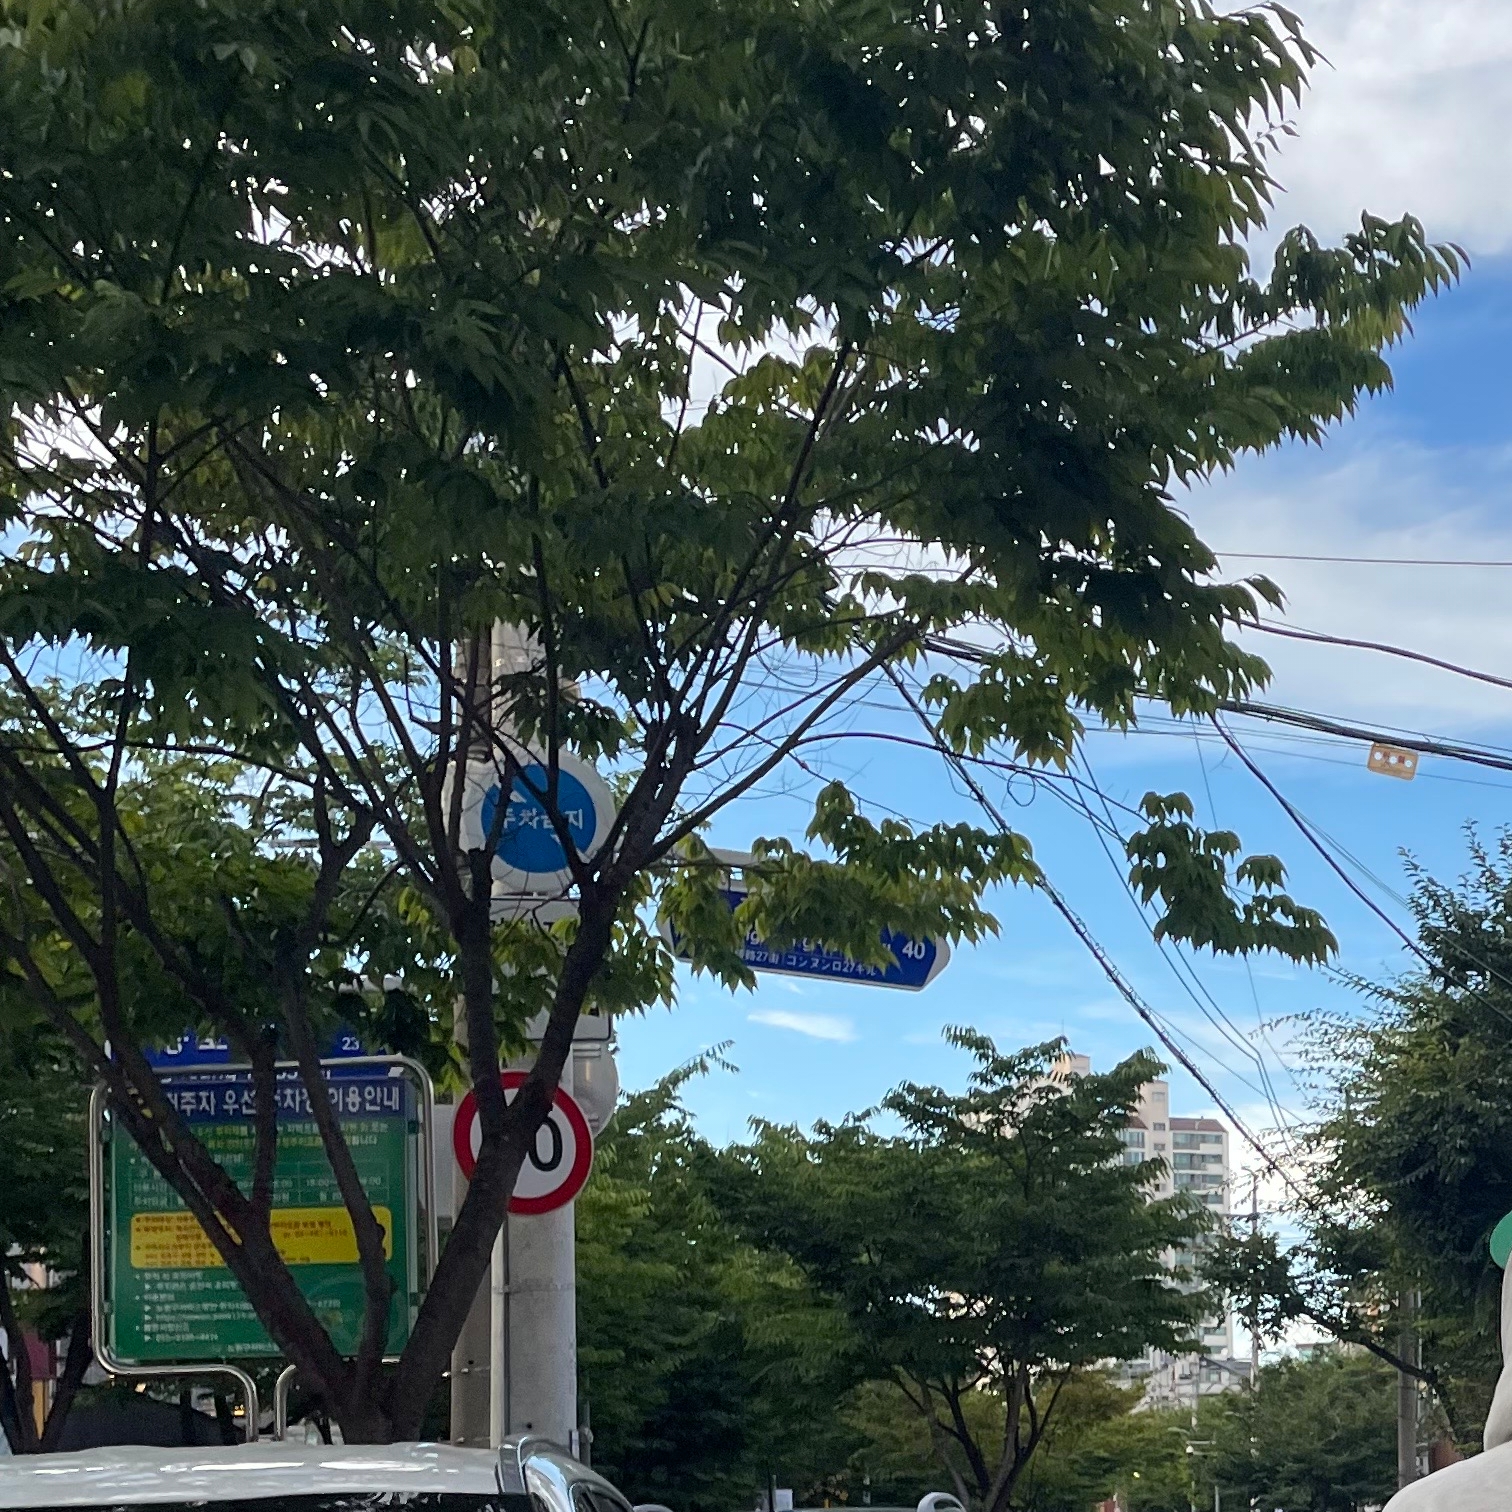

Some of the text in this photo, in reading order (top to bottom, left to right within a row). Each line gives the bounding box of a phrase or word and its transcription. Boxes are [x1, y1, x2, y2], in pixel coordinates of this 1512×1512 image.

[901, 940, 926, 960] 40
[328, 1086, 400, 1113] 이용안내
[528, 1115, 563, 1172] 0
